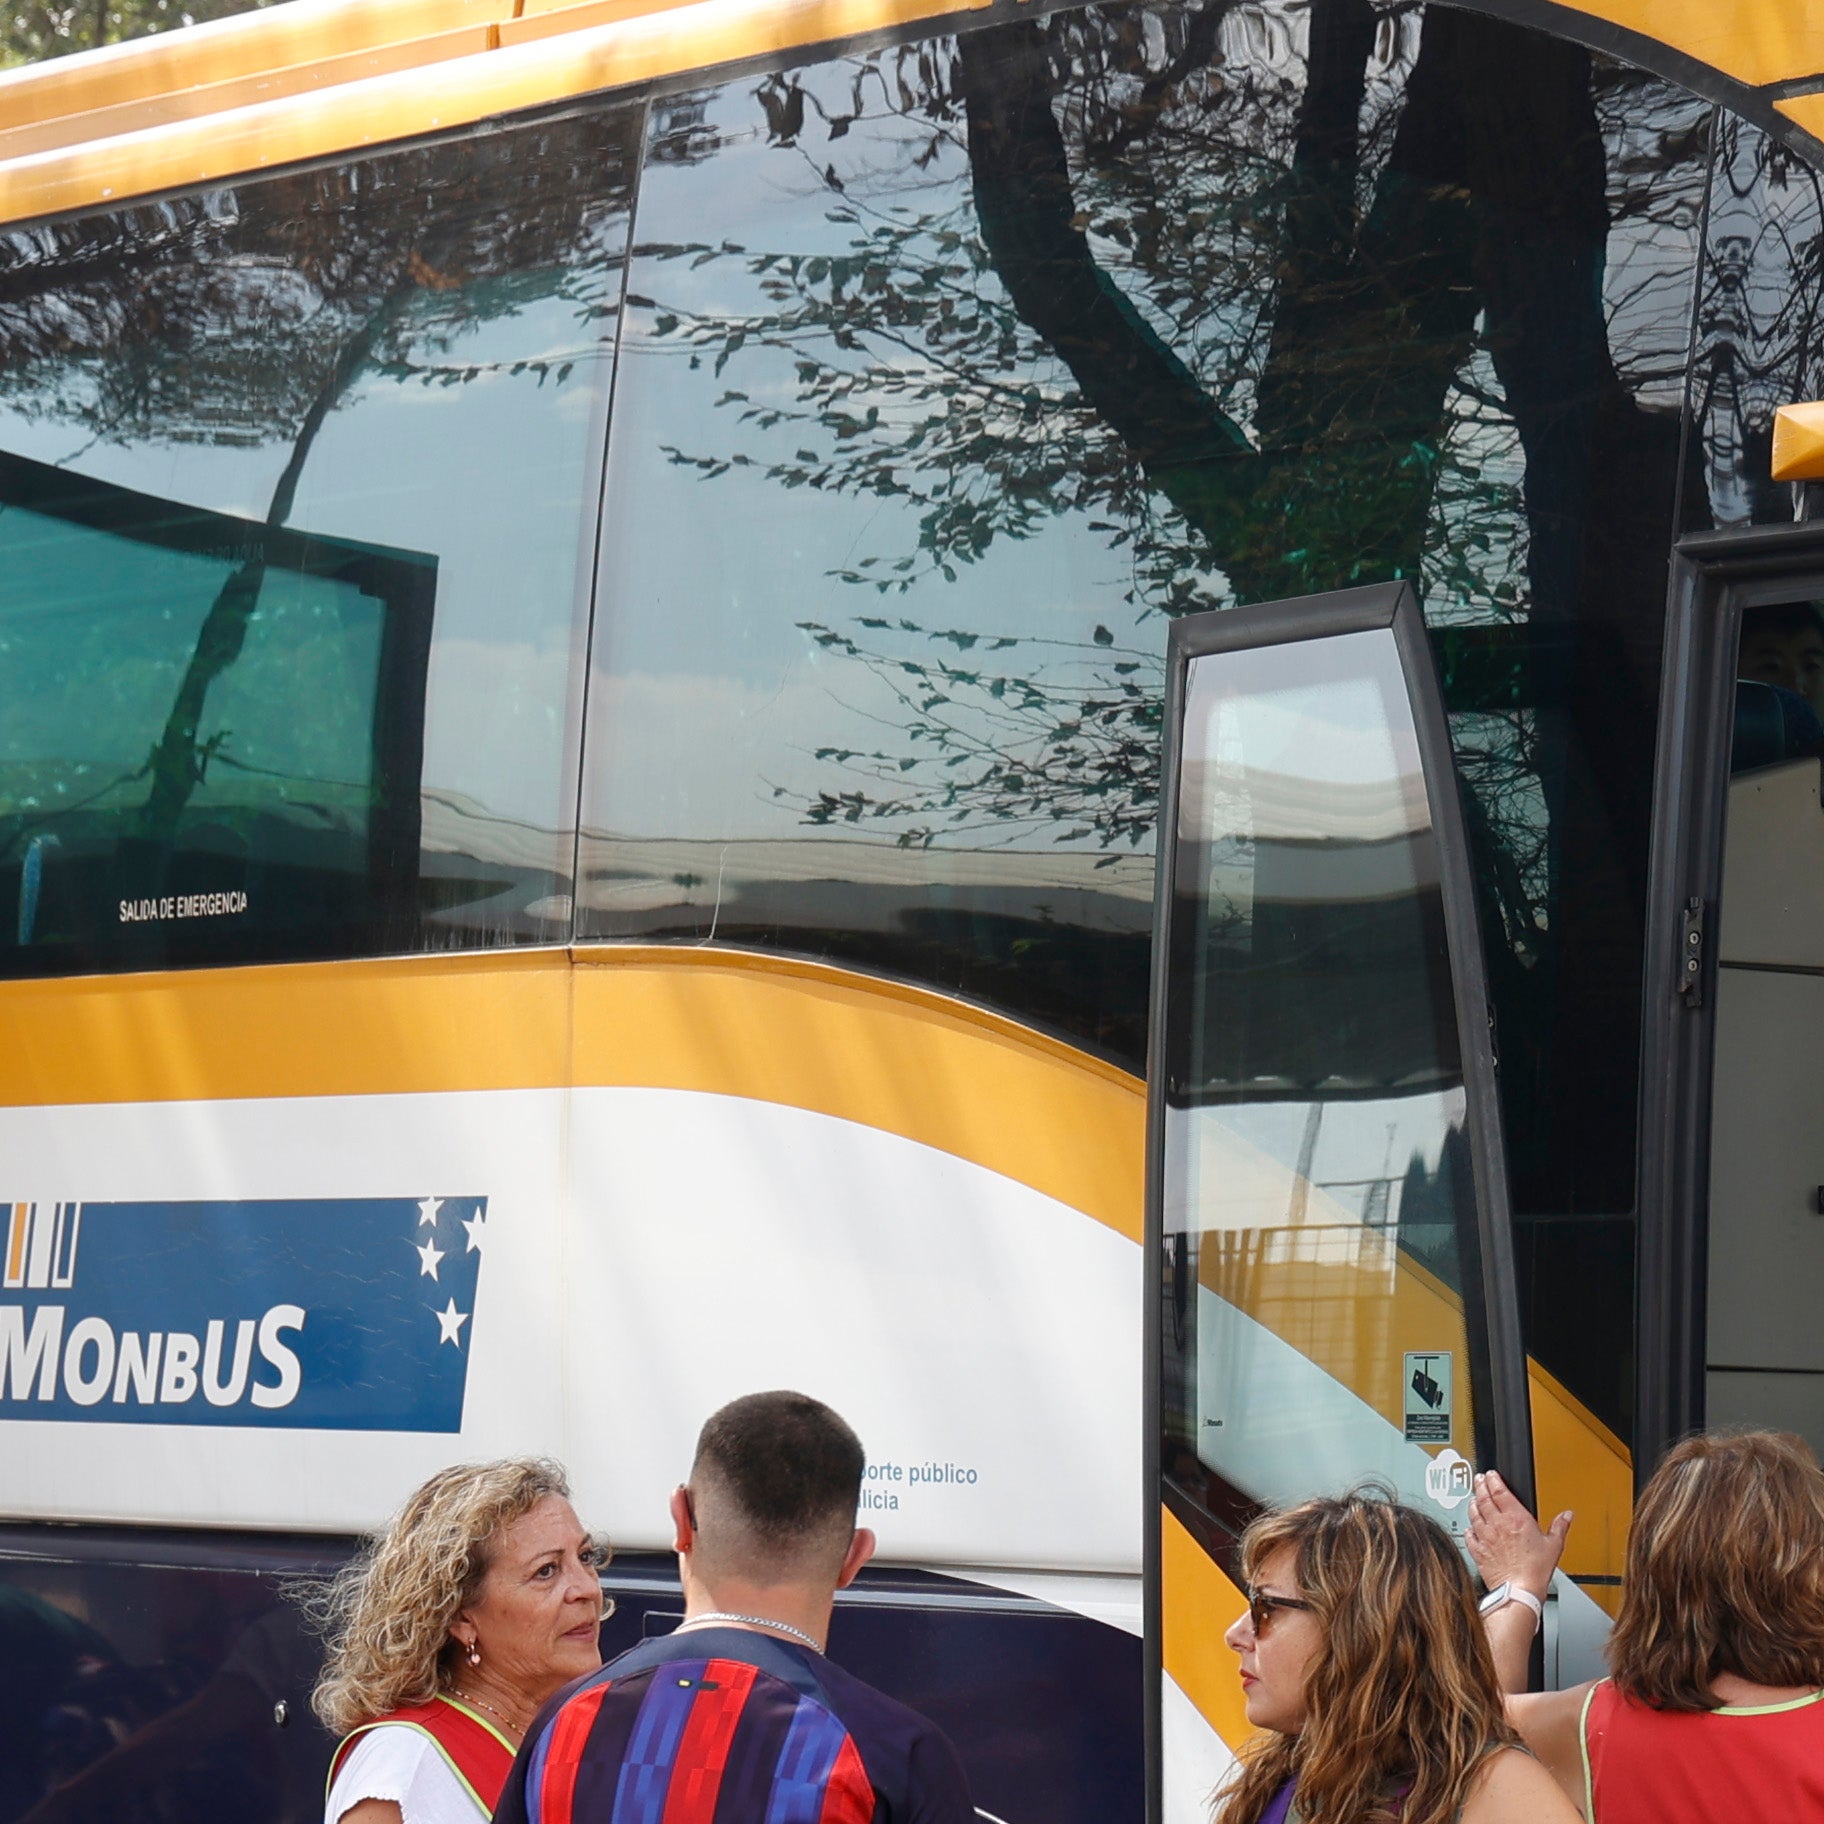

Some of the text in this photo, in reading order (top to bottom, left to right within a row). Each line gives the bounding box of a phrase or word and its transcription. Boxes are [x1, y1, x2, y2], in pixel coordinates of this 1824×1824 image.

[119, 891, 248, 922] SALIDA DE EMERGENCIA
[909, 1461, 978, 1486] público
